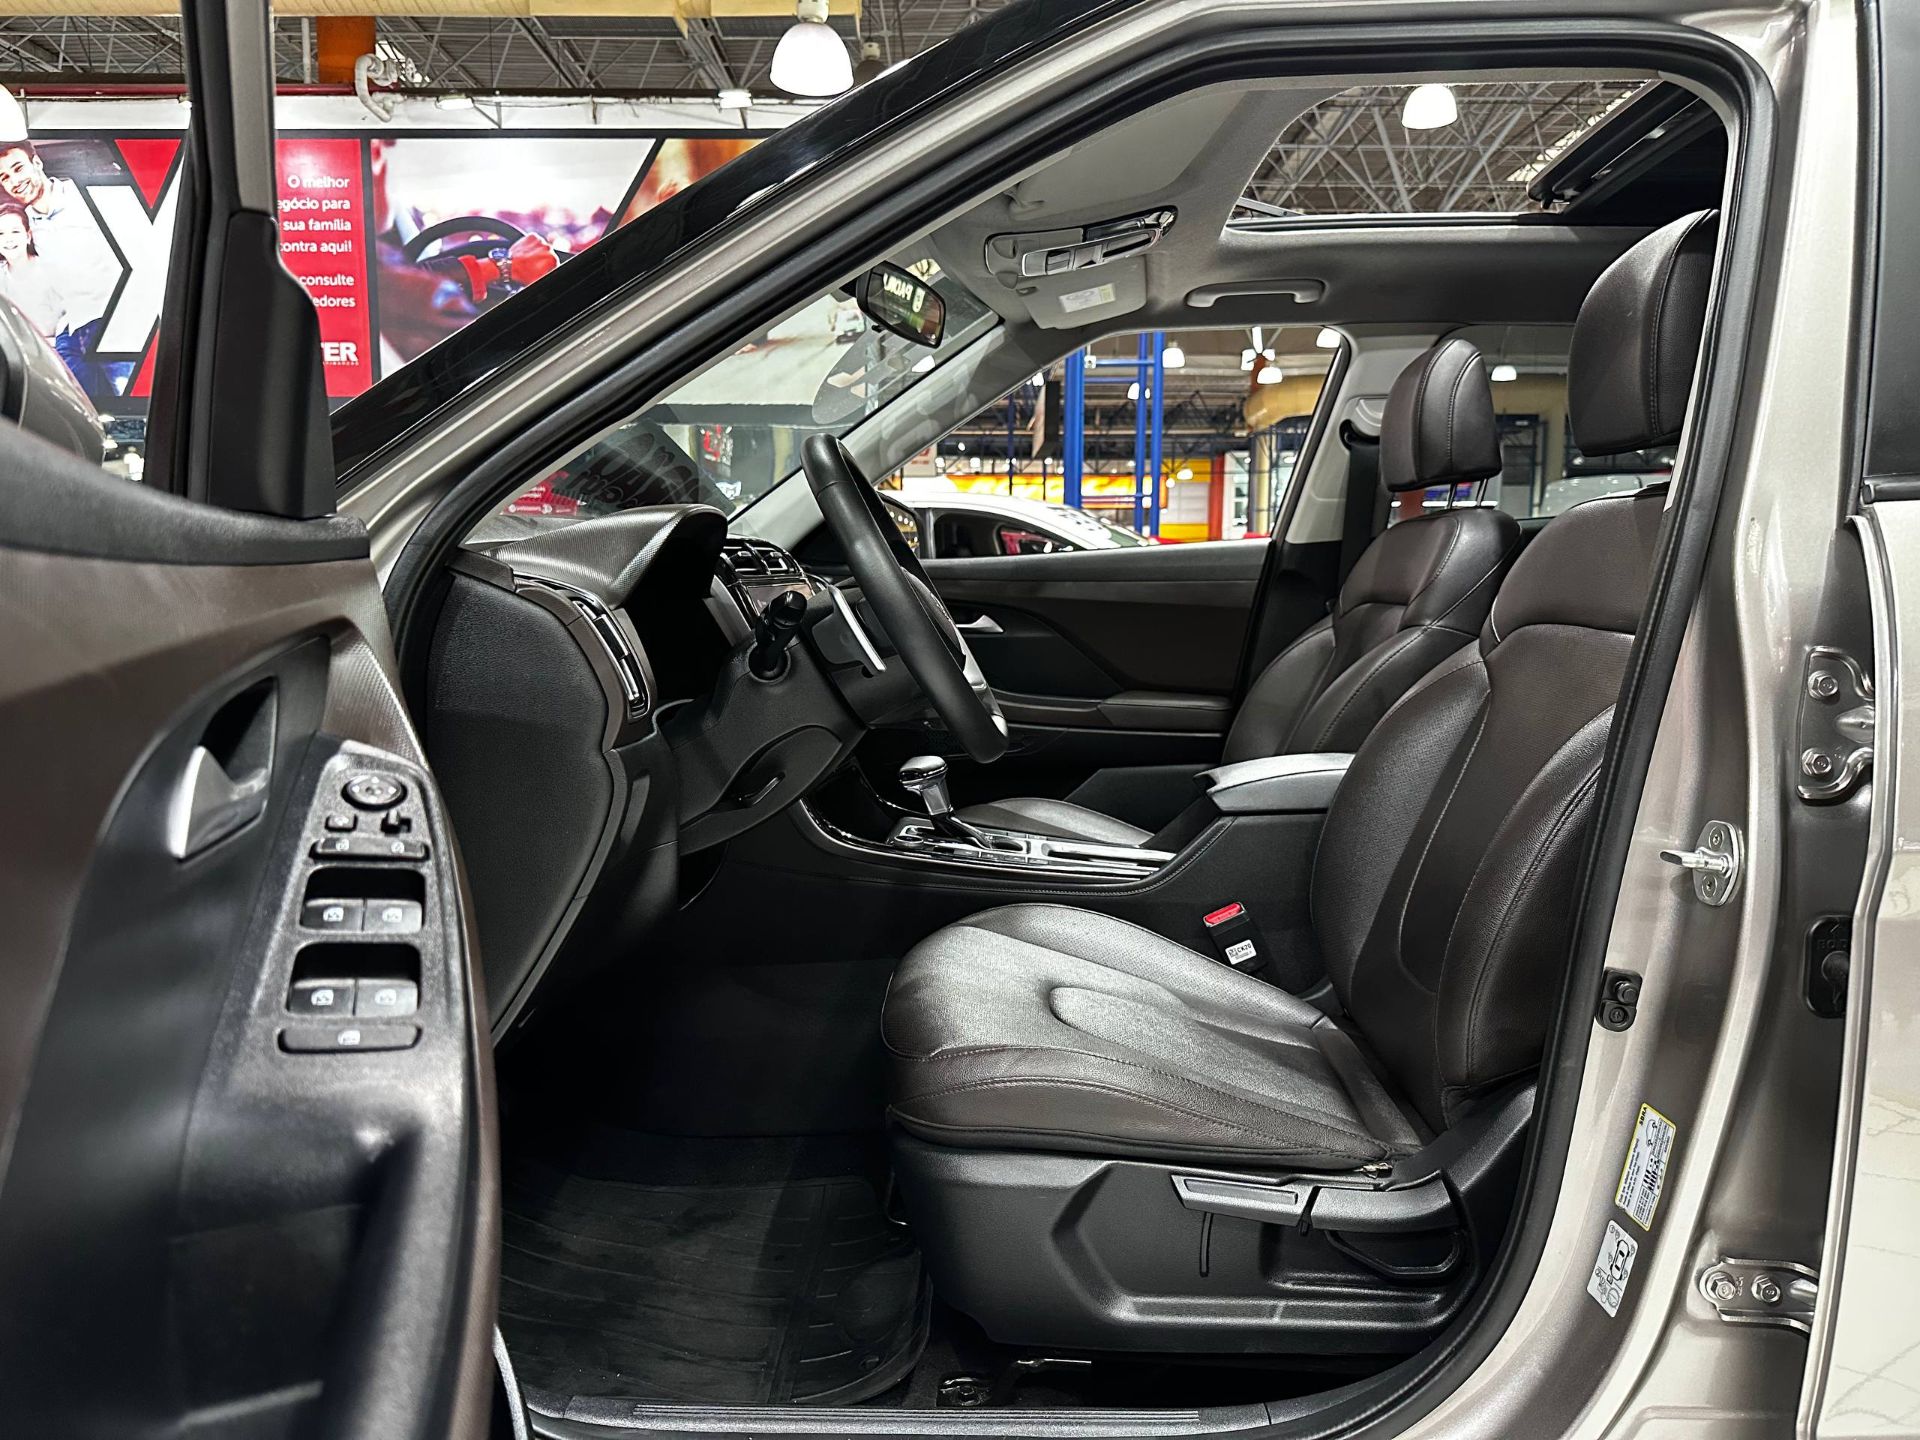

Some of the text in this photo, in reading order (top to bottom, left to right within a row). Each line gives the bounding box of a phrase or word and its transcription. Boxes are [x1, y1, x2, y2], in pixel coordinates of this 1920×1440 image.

[287, 175, 350, 188] O melhor
[322, 199, 351, 212] para
[283, 218, 352, 231] sua família
[280, 240, 352, 255] ontra aqui!
[299, 274, 355, 286] consulte
[320, 341, 359, 362] ER
